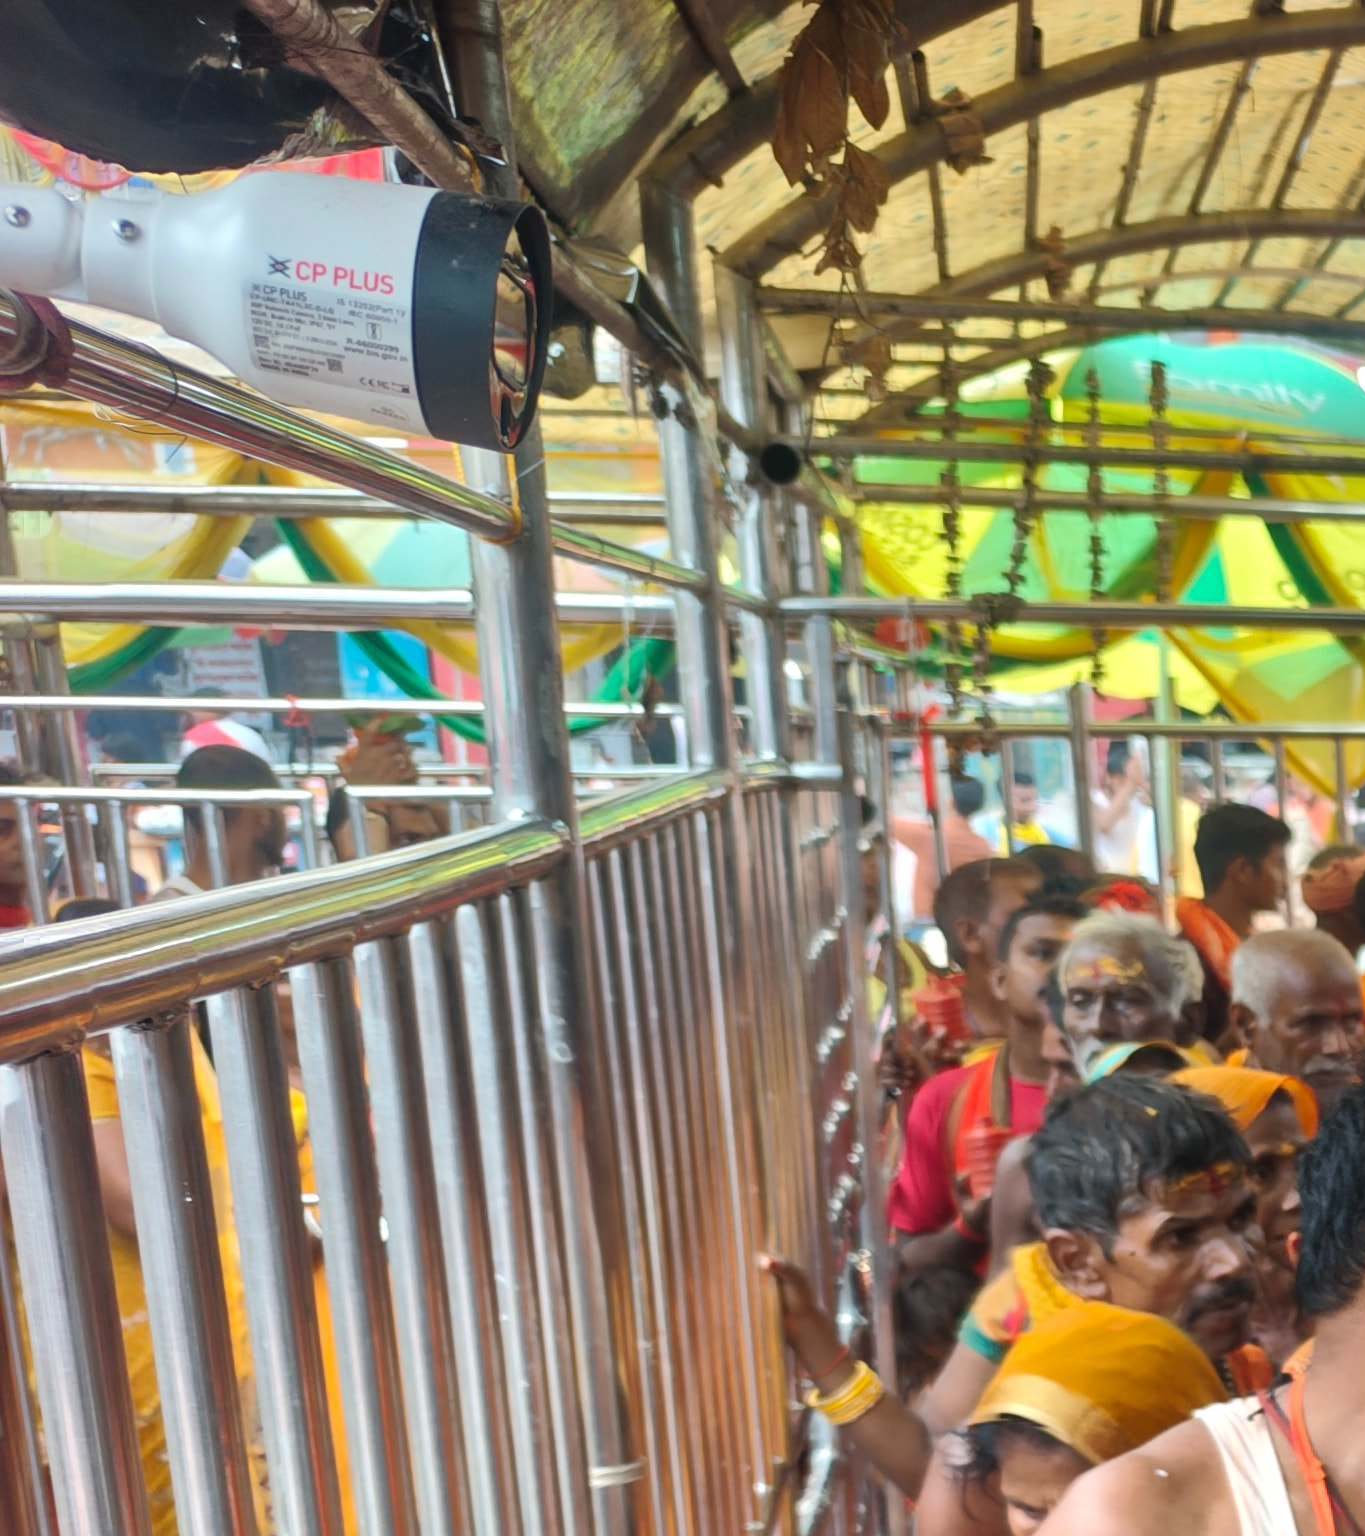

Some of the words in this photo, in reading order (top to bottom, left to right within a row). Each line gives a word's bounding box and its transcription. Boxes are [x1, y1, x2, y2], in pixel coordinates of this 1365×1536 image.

[294, 260, 327, 283] CP
[333, 266, 395, 295] PLUS
[263, 284, 278, 295] CP
[279, 287, 308, 302] PLUS
